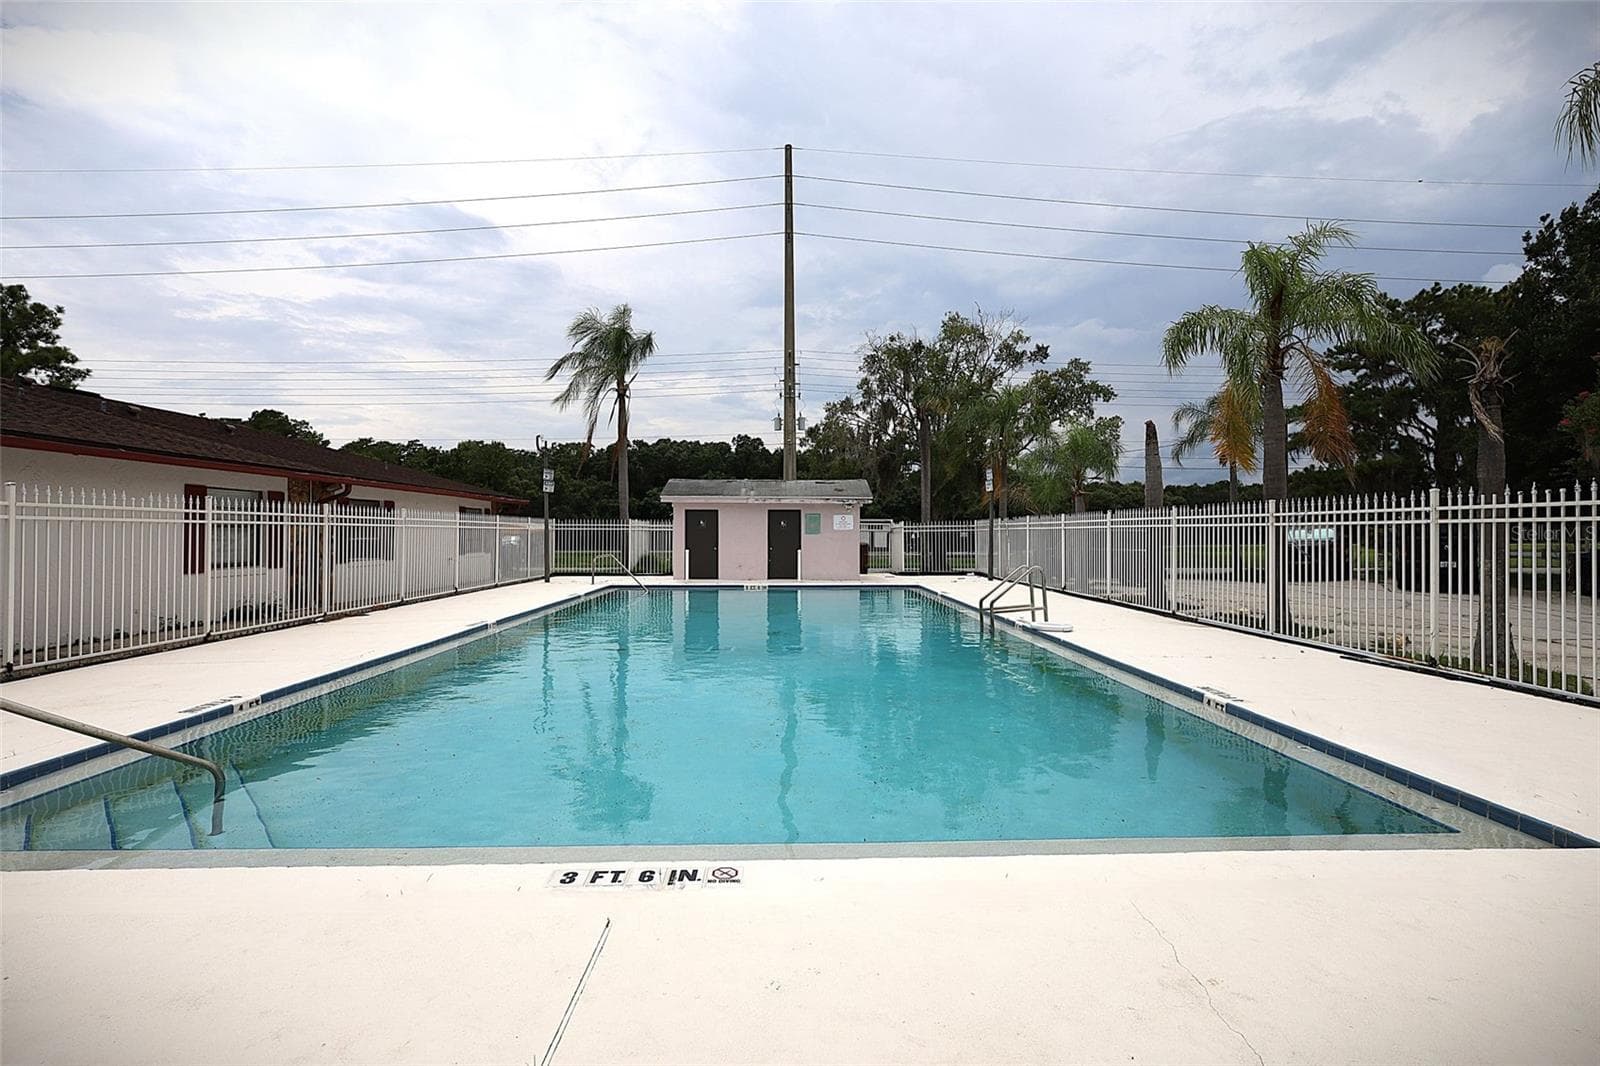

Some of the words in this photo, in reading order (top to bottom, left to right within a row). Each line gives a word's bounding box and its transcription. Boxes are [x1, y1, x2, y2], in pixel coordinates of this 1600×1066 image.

[560, 872, 578, 884] 3
[590, 870, 626, 883] FT.
[638, 870, 655, 882] 6
[667, 869, 701, 885] IN.
